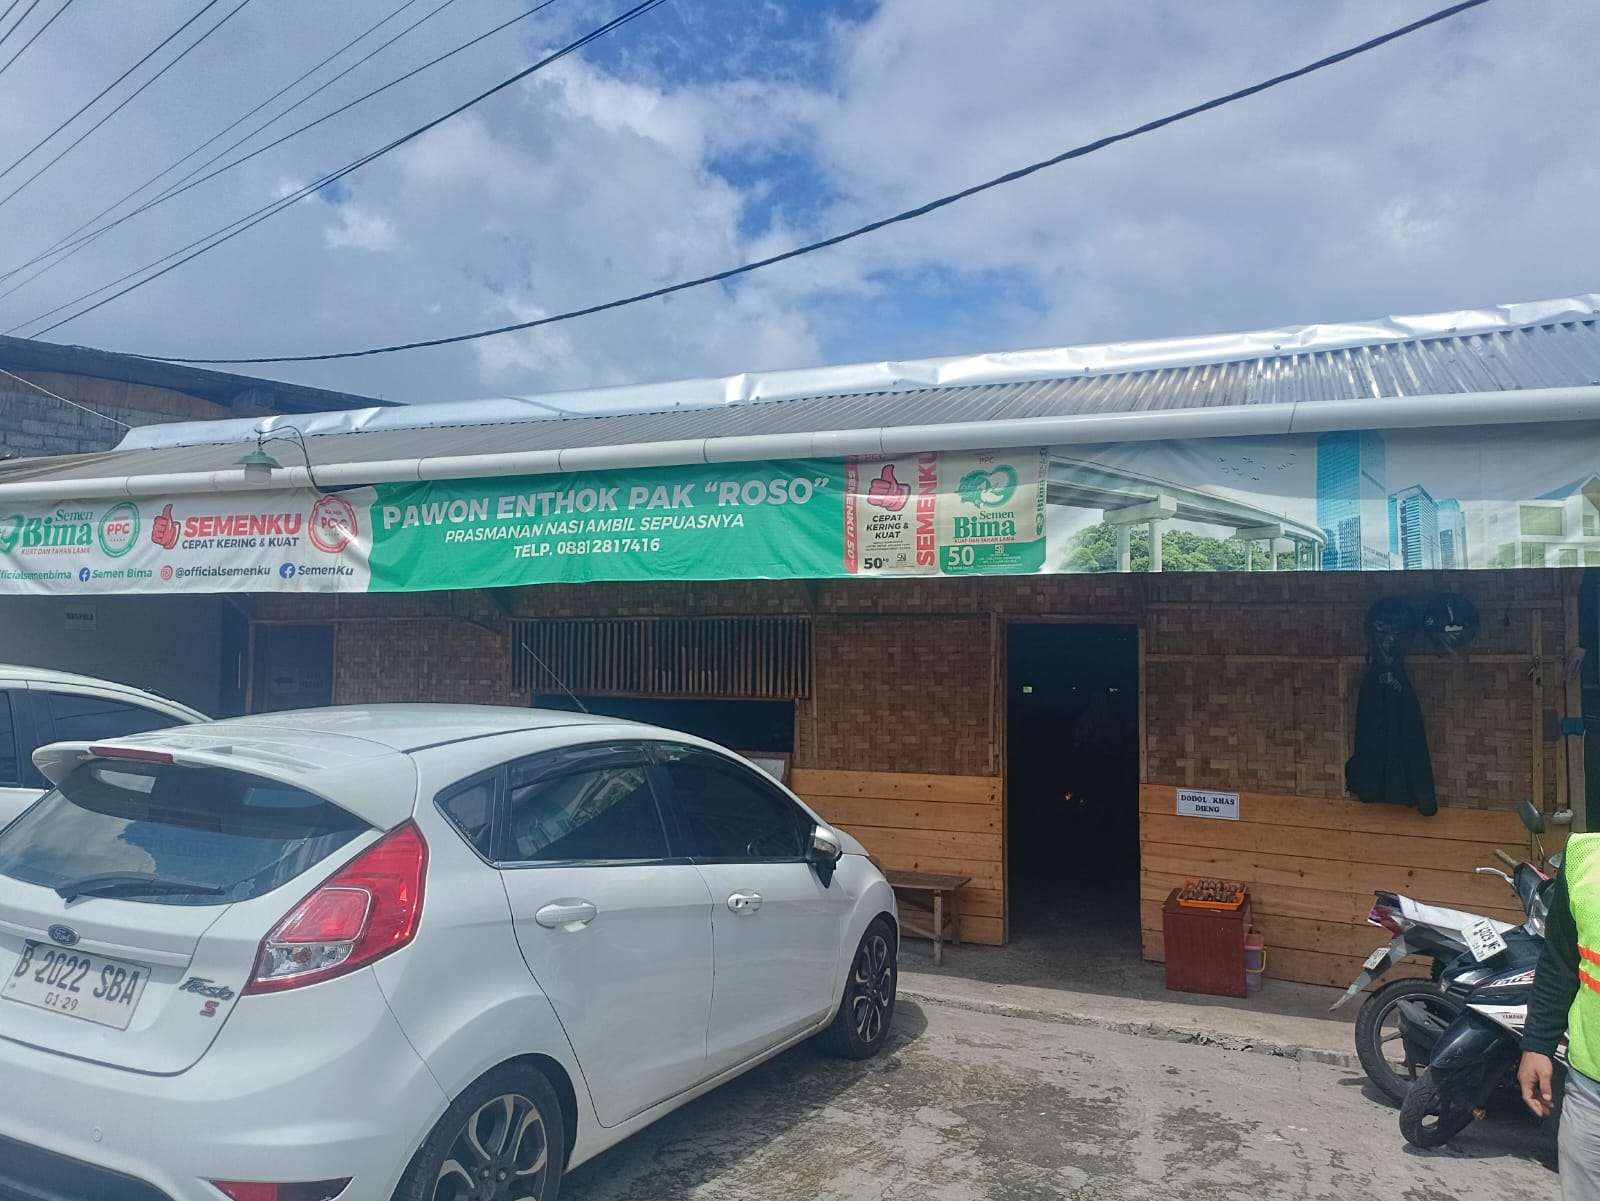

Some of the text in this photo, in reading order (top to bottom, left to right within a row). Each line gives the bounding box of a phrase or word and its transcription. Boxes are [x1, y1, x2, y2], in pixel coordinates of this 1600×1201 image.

[382, 497, 489, 530] PAWON
[497, 487, 621, 520] ENTHOK
[628, 484, 696, 510] PAK
[55, 508, 95, 522] Semen
[872, 514, 903, 523] CEPAT
[979, 511, 1014, 519] Semen
[21, 516, 94, 547] Bima
[106, 523, 130, 535] PPC
[183, 513, 302, 538] SEMENKU
[445, 513, 744, 543] PRASMANAN NASI AMBIL SEPUASNYA
[866, 523, 901, 531] KERING
[952, 516, 1016, 539] Bima
[874, 531, 902, 539] KUAT
[182, 537, 300, 549] CEPAT KERING & KUAT
[513, 542, 553, 558] TELP.
[947, 545, 975, 566] 50
[864, 557, 882, 569] 50
[92, 568, 124, 579] Semen
[127, 568, 153, 578] Bima
[175, 564, 271, 578] @officialsemenku
[298, 564, 354, 577] SemenKu
[1181, 794, 1235, 805] DODOL KHAS
[1195, 804, 1220, 813] DIENG
[15, 947, 140, 1006] B 2022 SBA
[178, 976, 235, 1000] Fiesta
[200, 1000, 220, 1018] S
